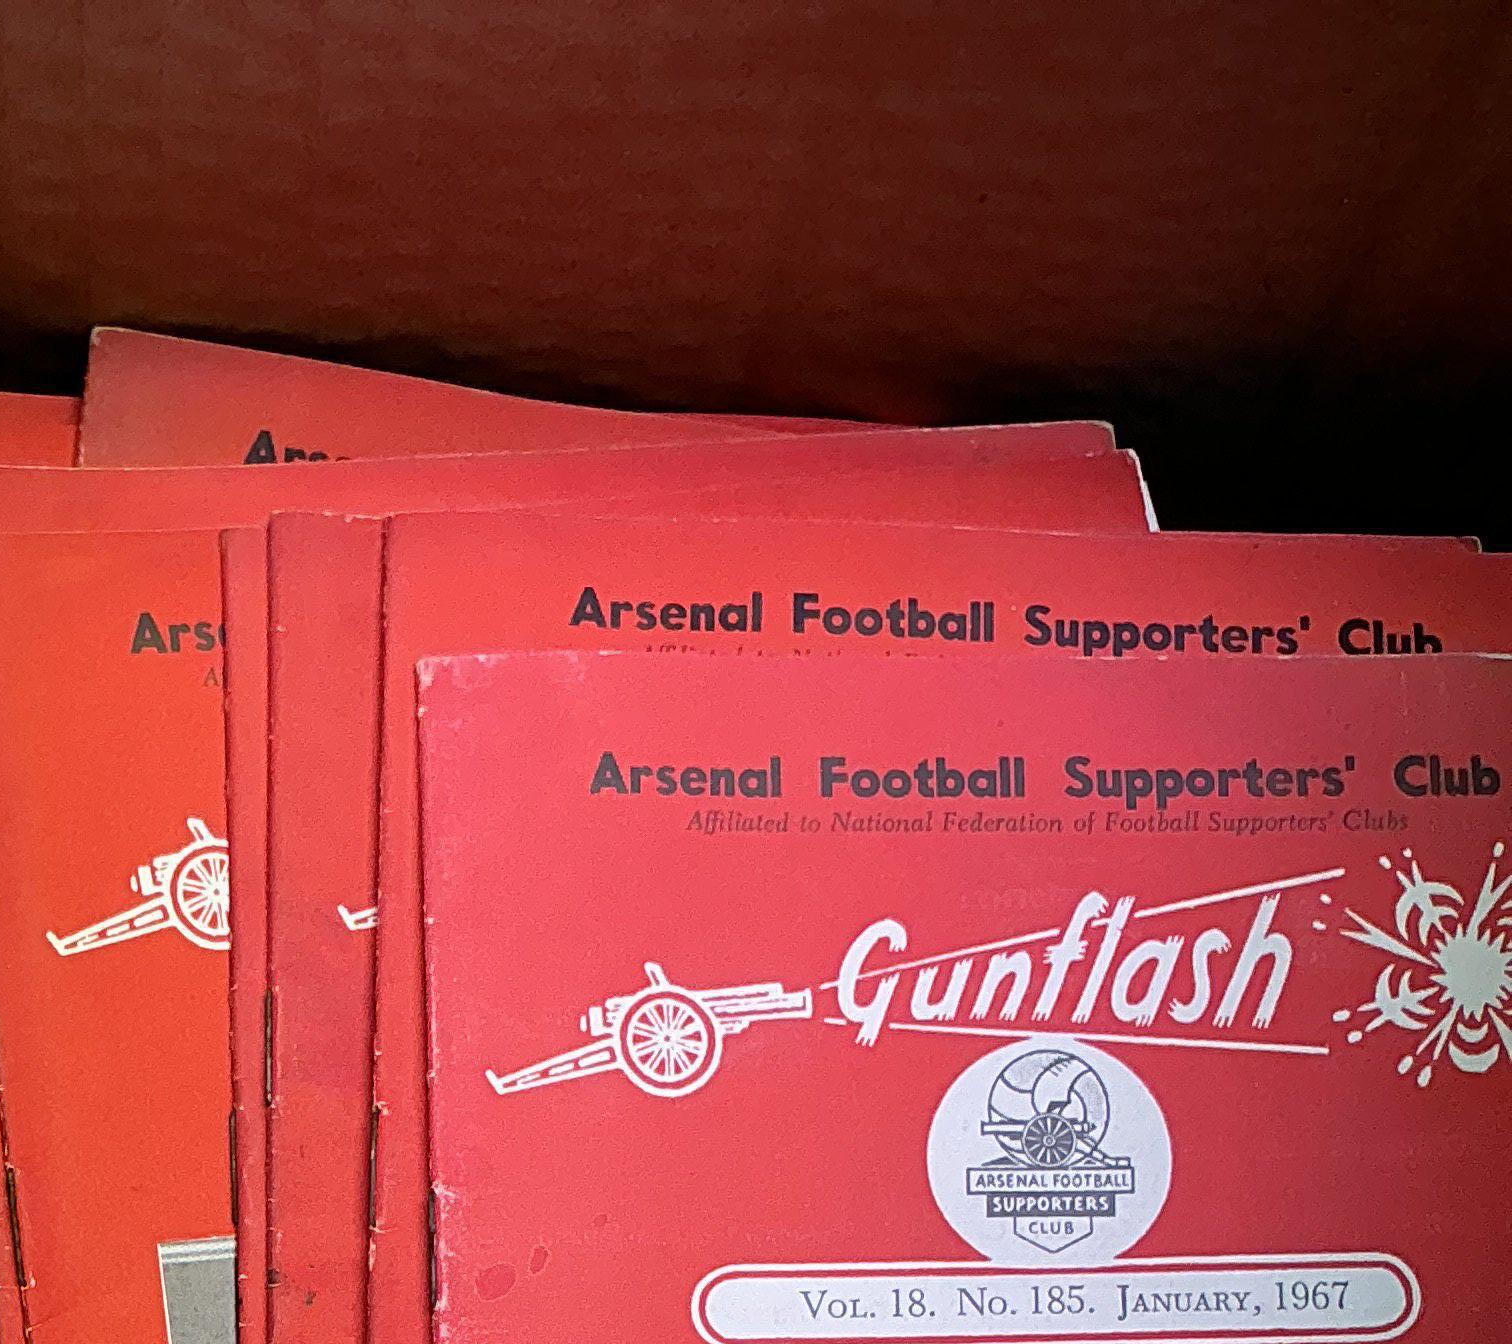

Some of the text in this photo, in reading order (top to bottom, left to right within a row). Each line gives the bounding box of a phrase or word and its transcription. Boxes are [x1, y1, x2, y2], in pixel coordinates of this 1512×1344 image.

[569, 587, 1443, 657] Arsenal Football Supporters' Club
[590, 752, 1501, 810] Arsenal Football Supporters' Club
[687, 809, 1409, 837] Affiliated National Federation Football Supporters' Clubs
[838, 891, 1293, 1043] Gunflash
[974, 1173, 1130, 1188] ARSENAL FOOTBALL
[992, 1196, 1110, 1213] SUPPORTERS
[1028, 1221, 1075, 1235] CLUB
[800, 1279, 1350, 1321] VOL. 18. No. 185. JANUARY, 1967
